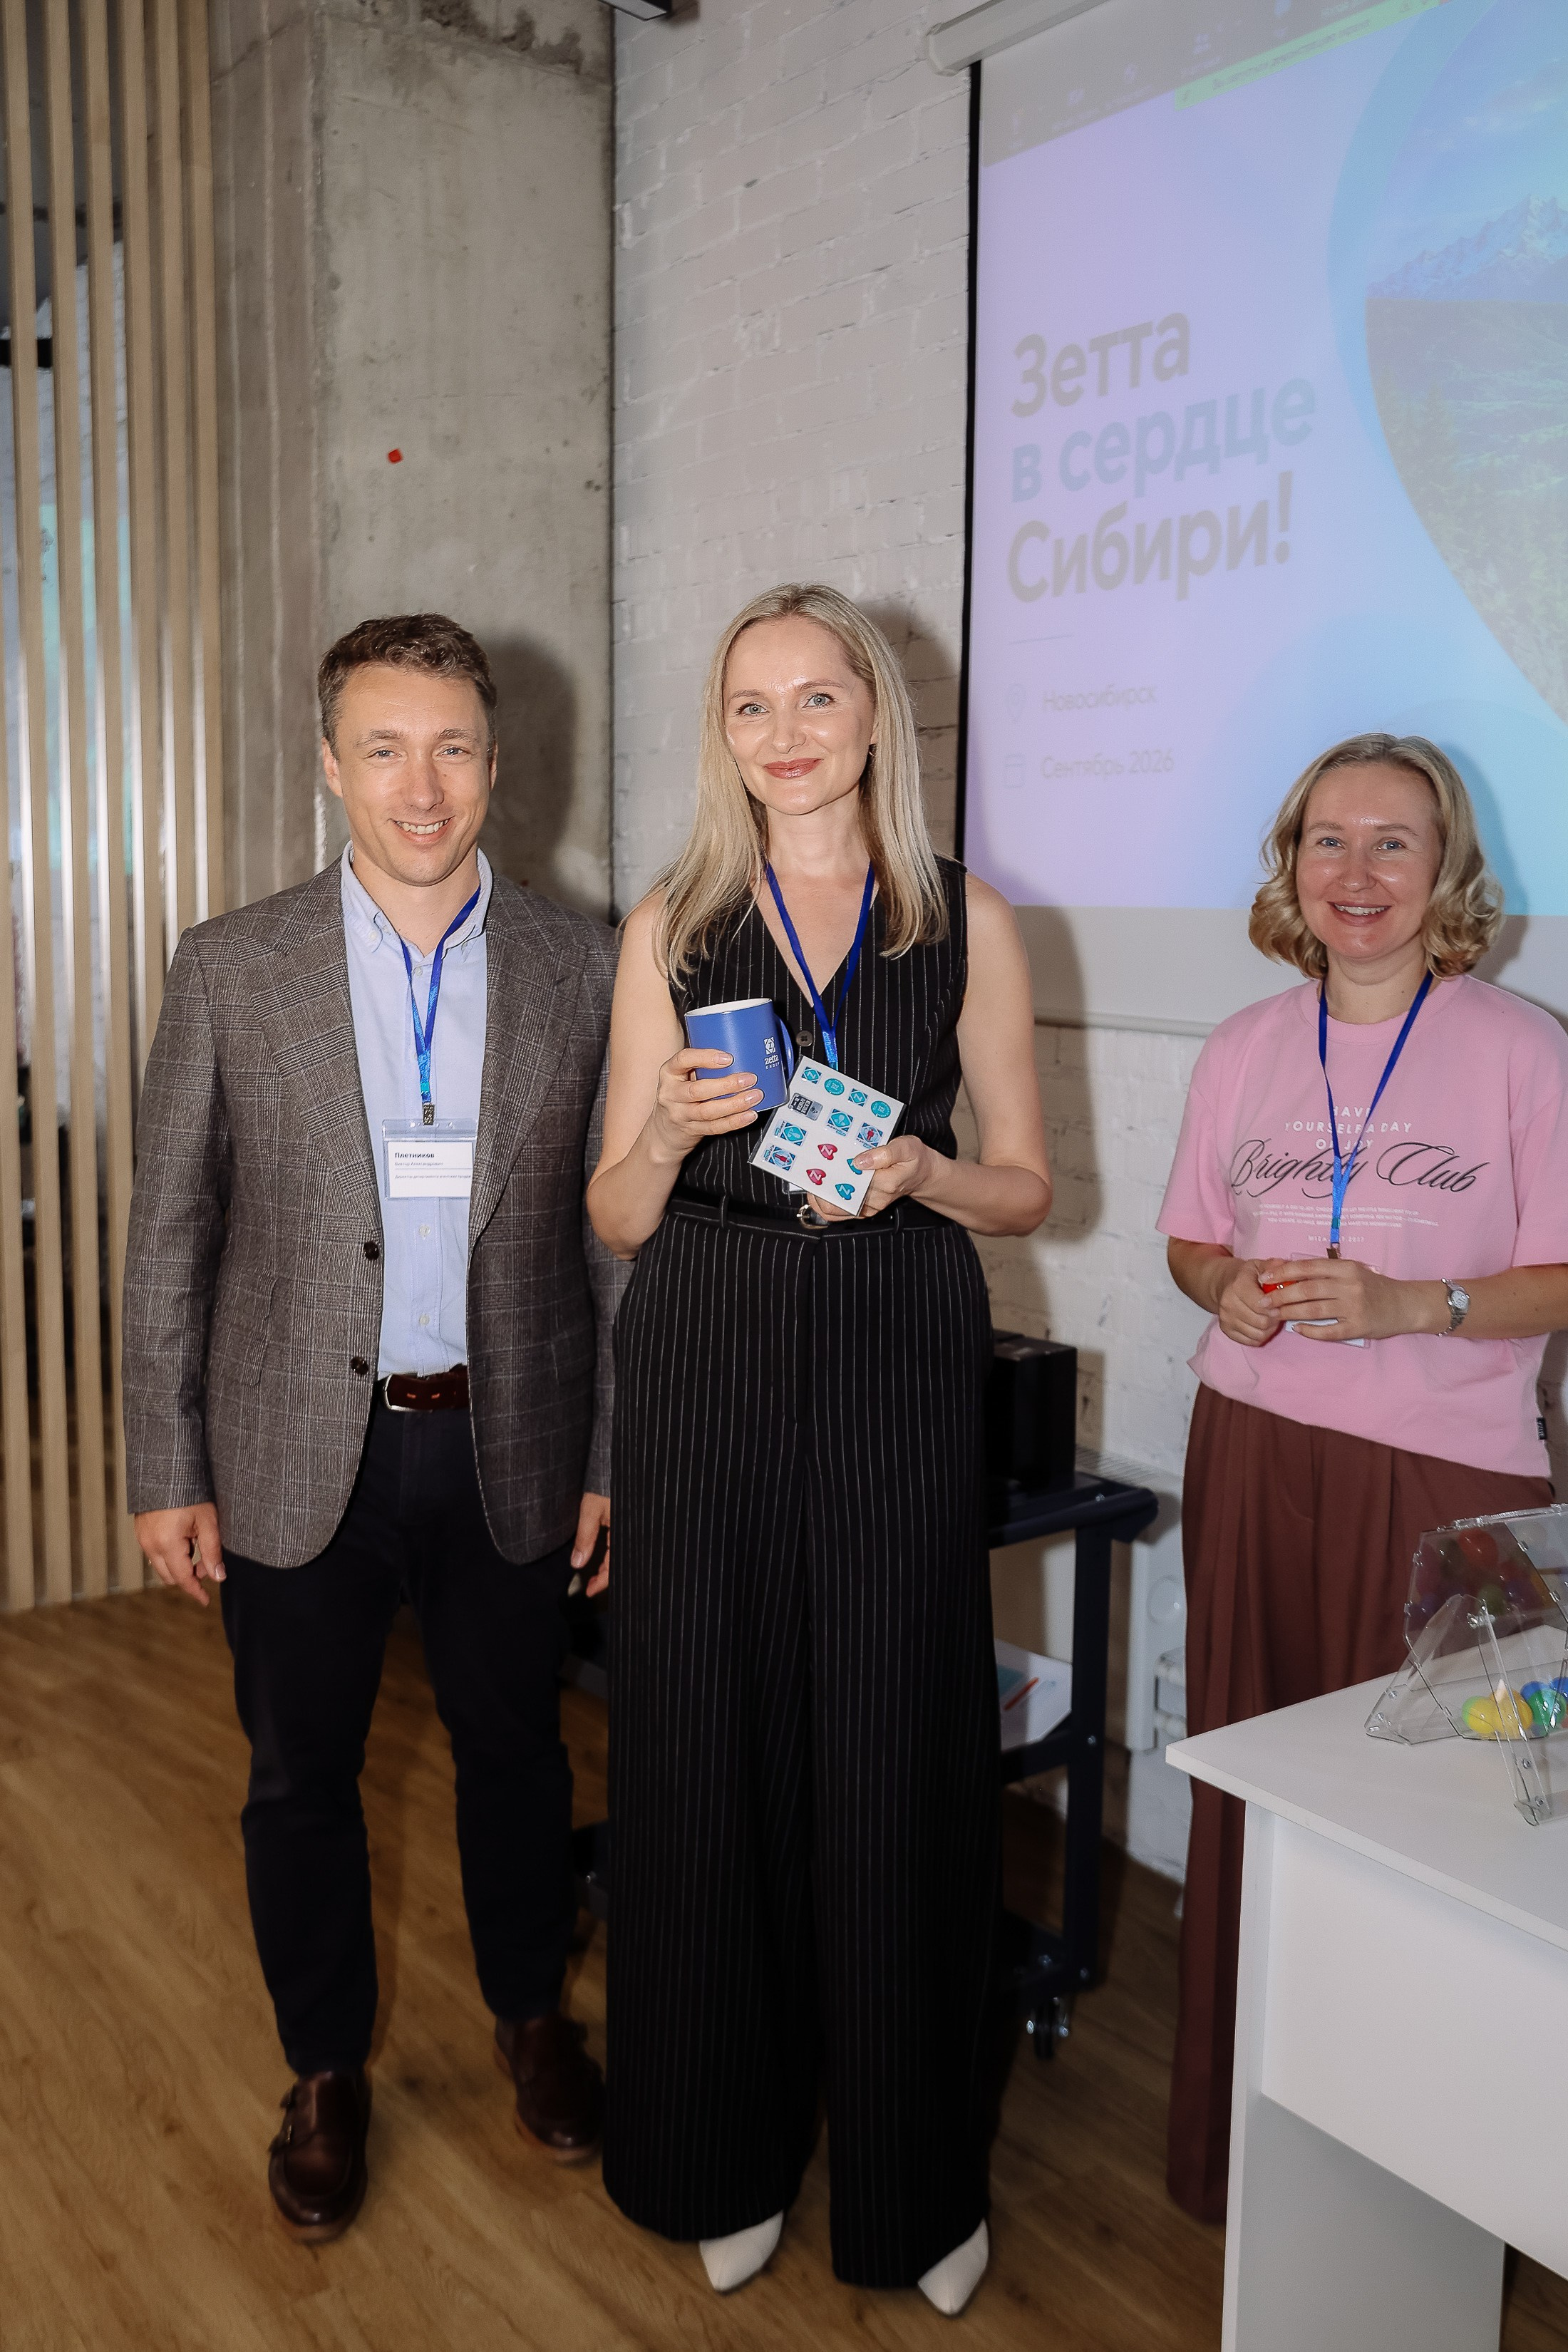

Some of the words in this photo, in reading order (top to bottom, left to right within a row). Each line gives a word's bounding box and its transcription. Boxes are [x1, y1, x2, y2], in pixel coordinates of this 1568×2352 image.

[1011, 313, 1190, 418] Зетта
[1011, 443, 1043, 503] в
[1059, 377, 1316, 499] сердце
[1007, 470, 1294, 604] Сибири!
[1042, 684, 1157, 711] Новосибирск
[1041, 752, 1125, 781] Сентябрь
[764, 1054, 779, 1065] zetta
[1380, 1121, 1412, 1133] DAY
[1376, 1142, 1490, 1192] Club
